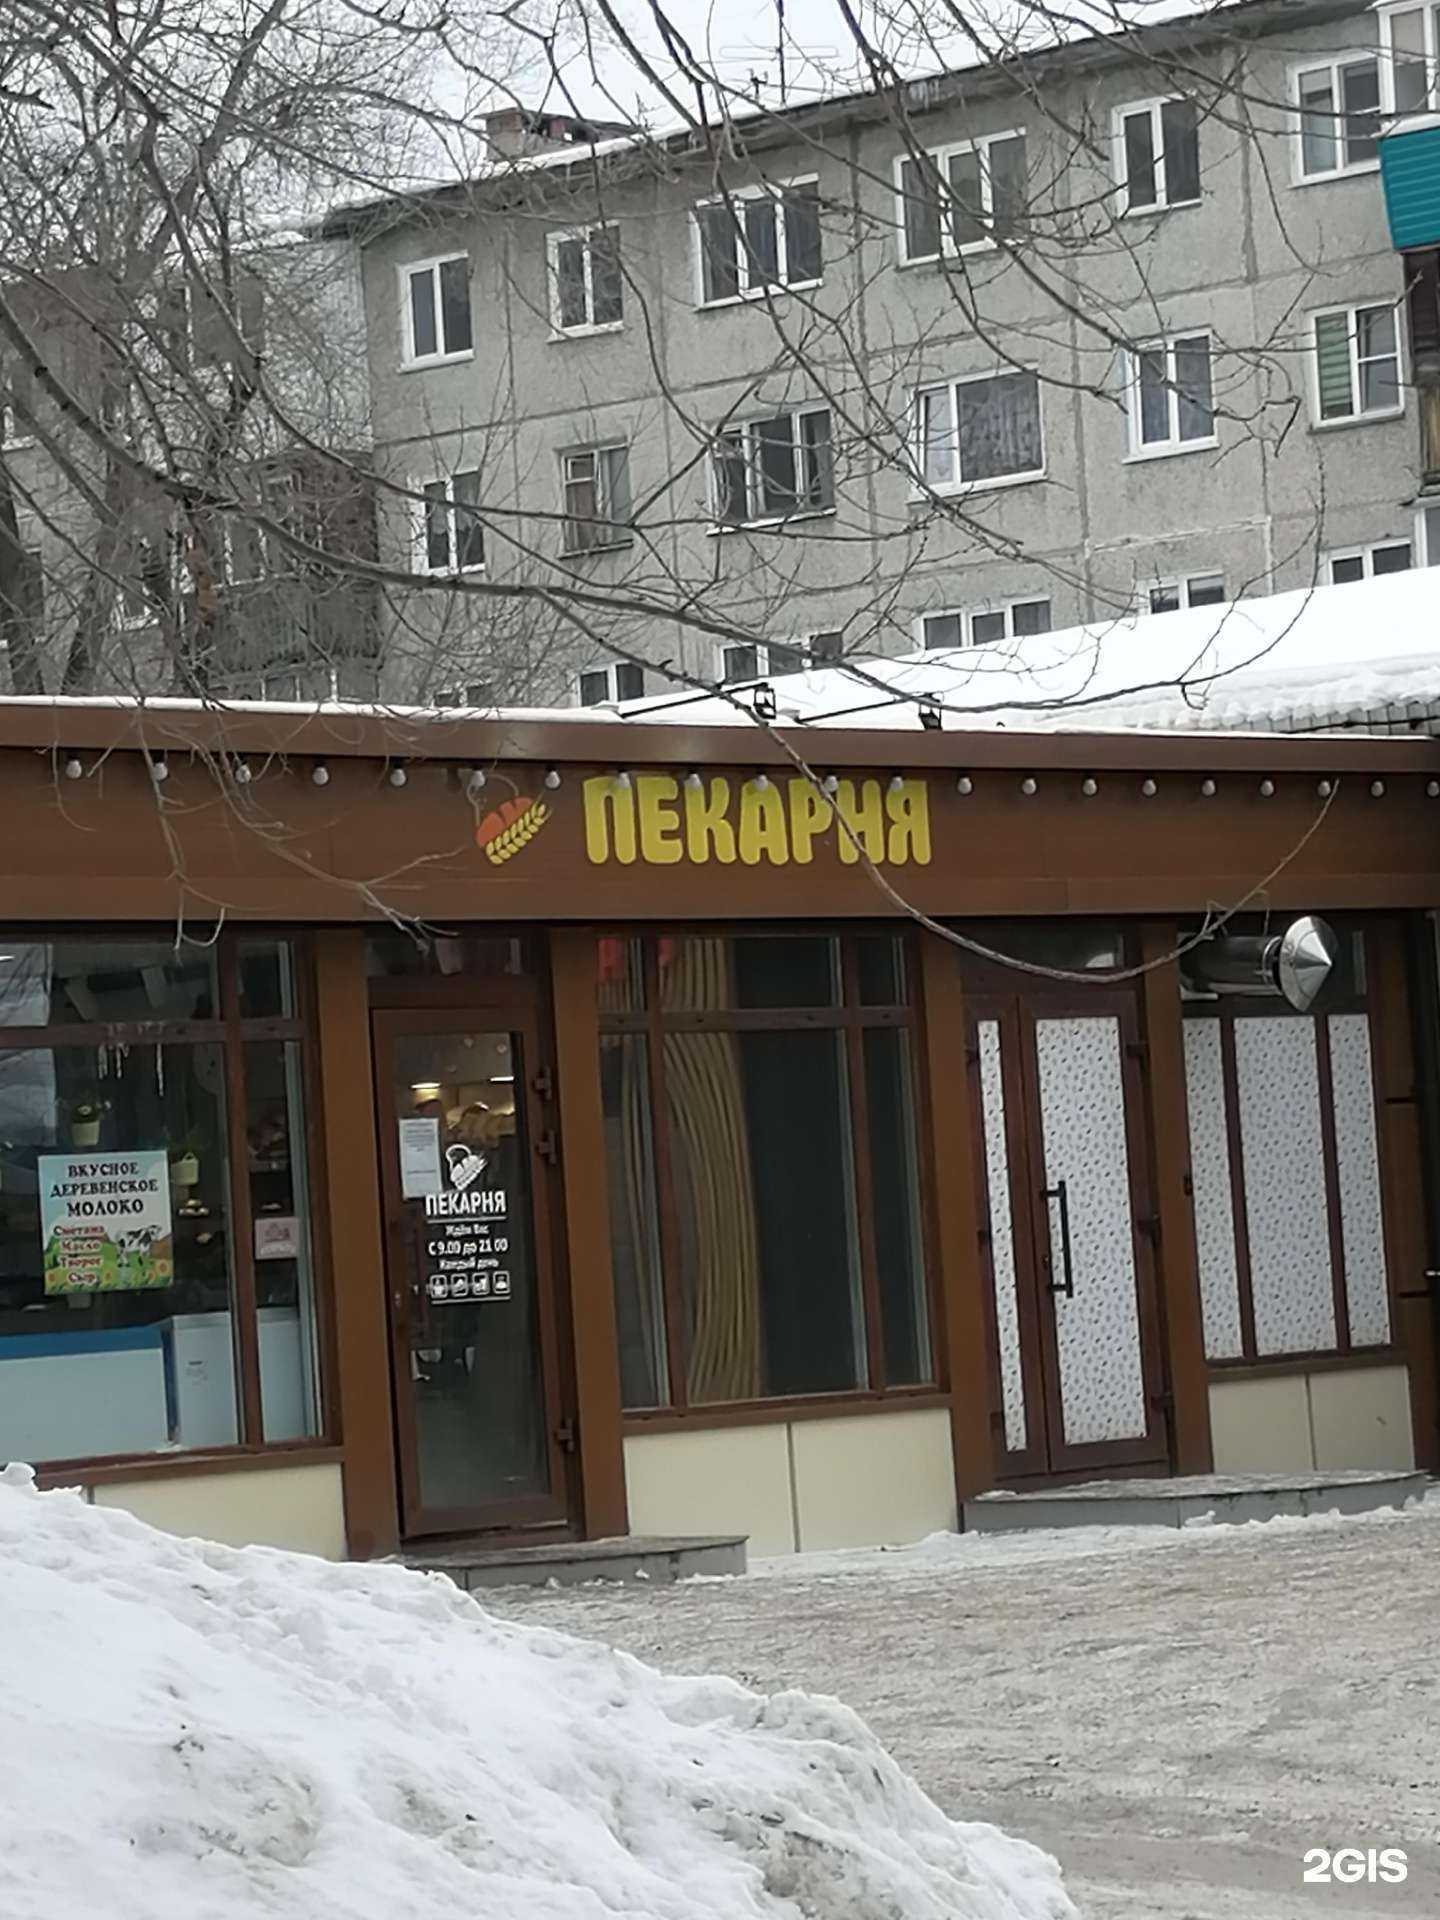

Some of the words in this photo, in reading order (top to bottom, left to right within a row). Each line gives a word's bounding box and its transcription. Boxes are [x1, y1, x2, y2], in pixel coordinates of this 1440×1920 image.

[583, 775, 932, 866] ПЕКАРНЯ
[67, 1162, 139, 1178] ВКУСНОЕ
[50, 1179, 159, 1198] ДЕРЕВЕНСКОЕ
[67, 1199, 144, 1217] МОЛОКО
[425, 1191, 507, 1216] ПЕКАРНЯ
